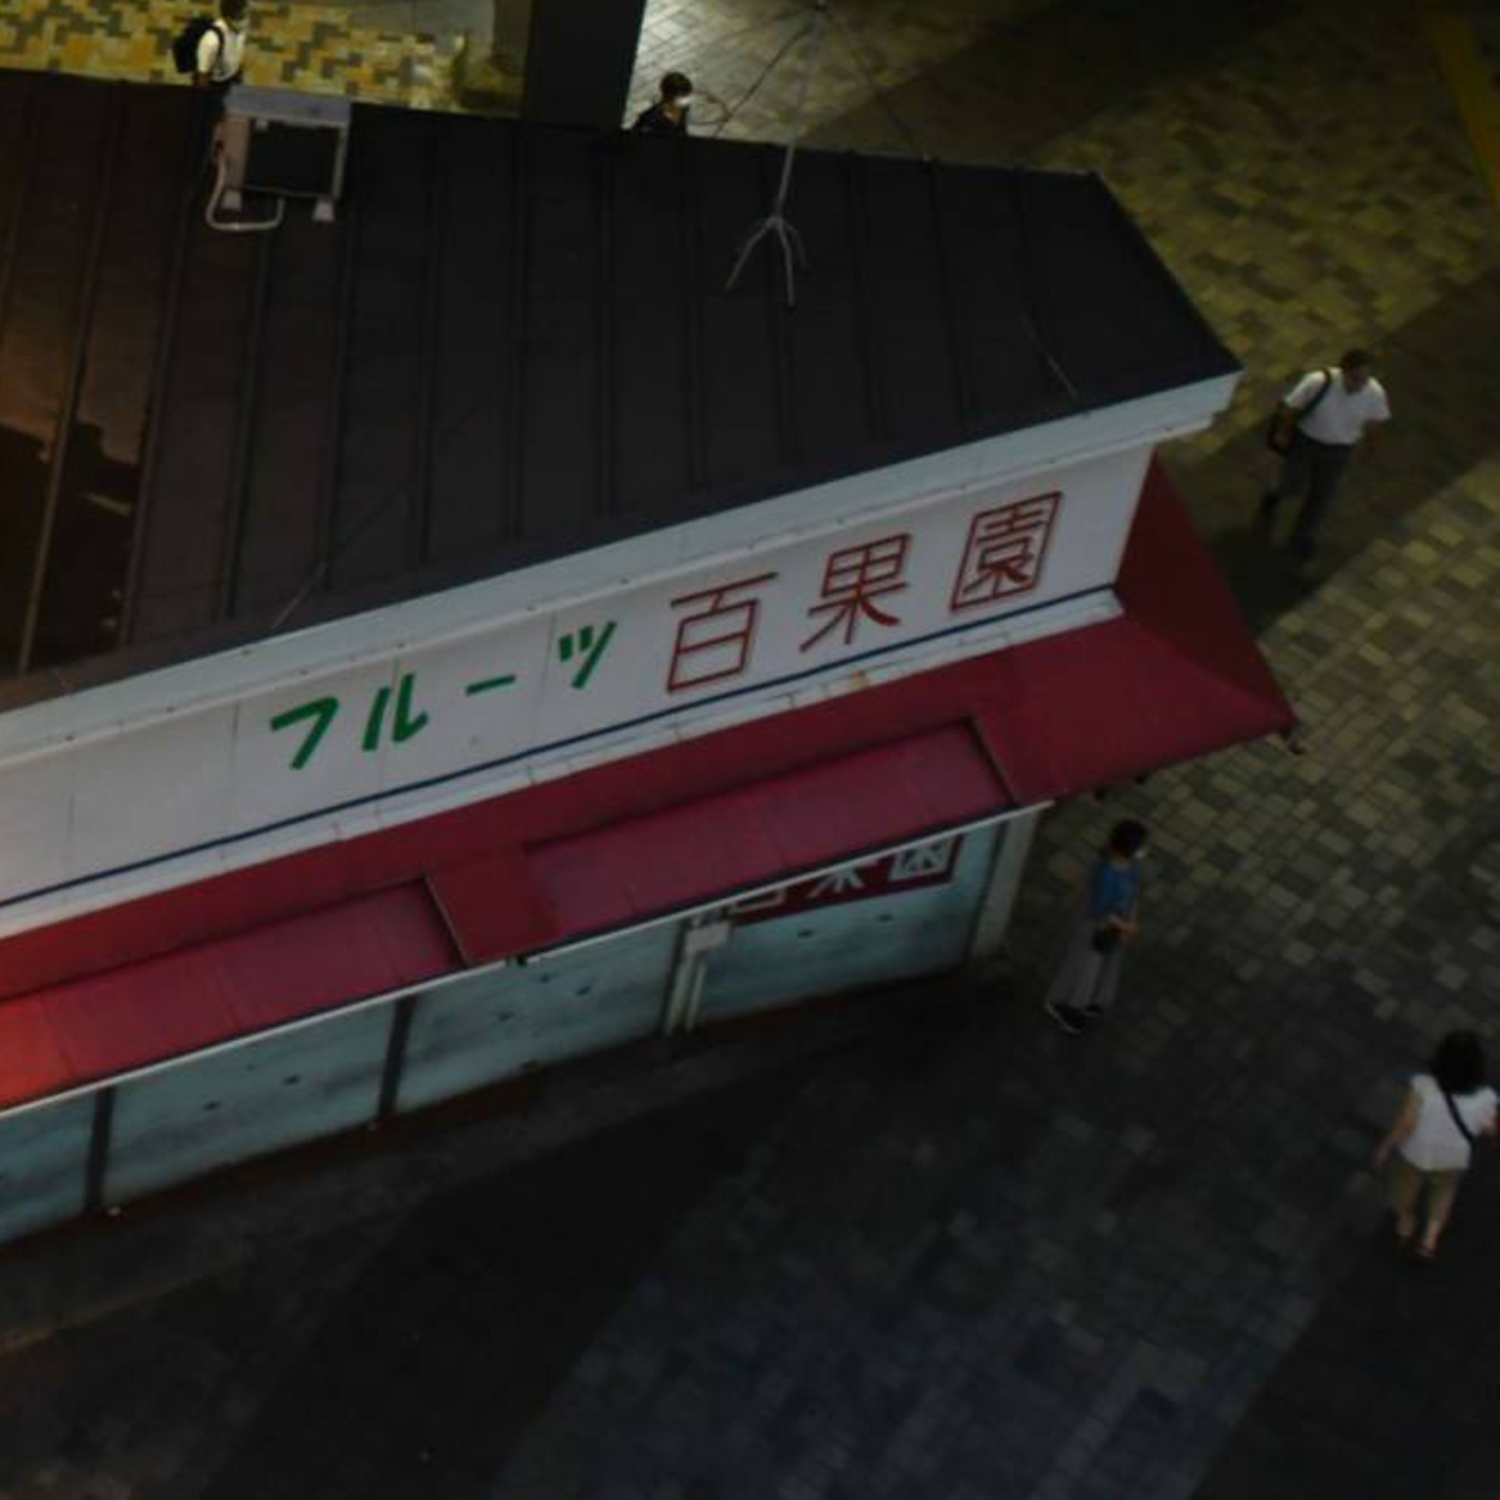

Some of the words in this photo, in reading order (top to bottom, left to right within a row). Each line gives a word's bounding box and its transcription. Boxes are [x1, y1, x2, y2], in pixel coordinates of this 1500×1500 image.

[269, 620, 617, 770] フルーツ
[666, 491, 1063, 694] 百果園
